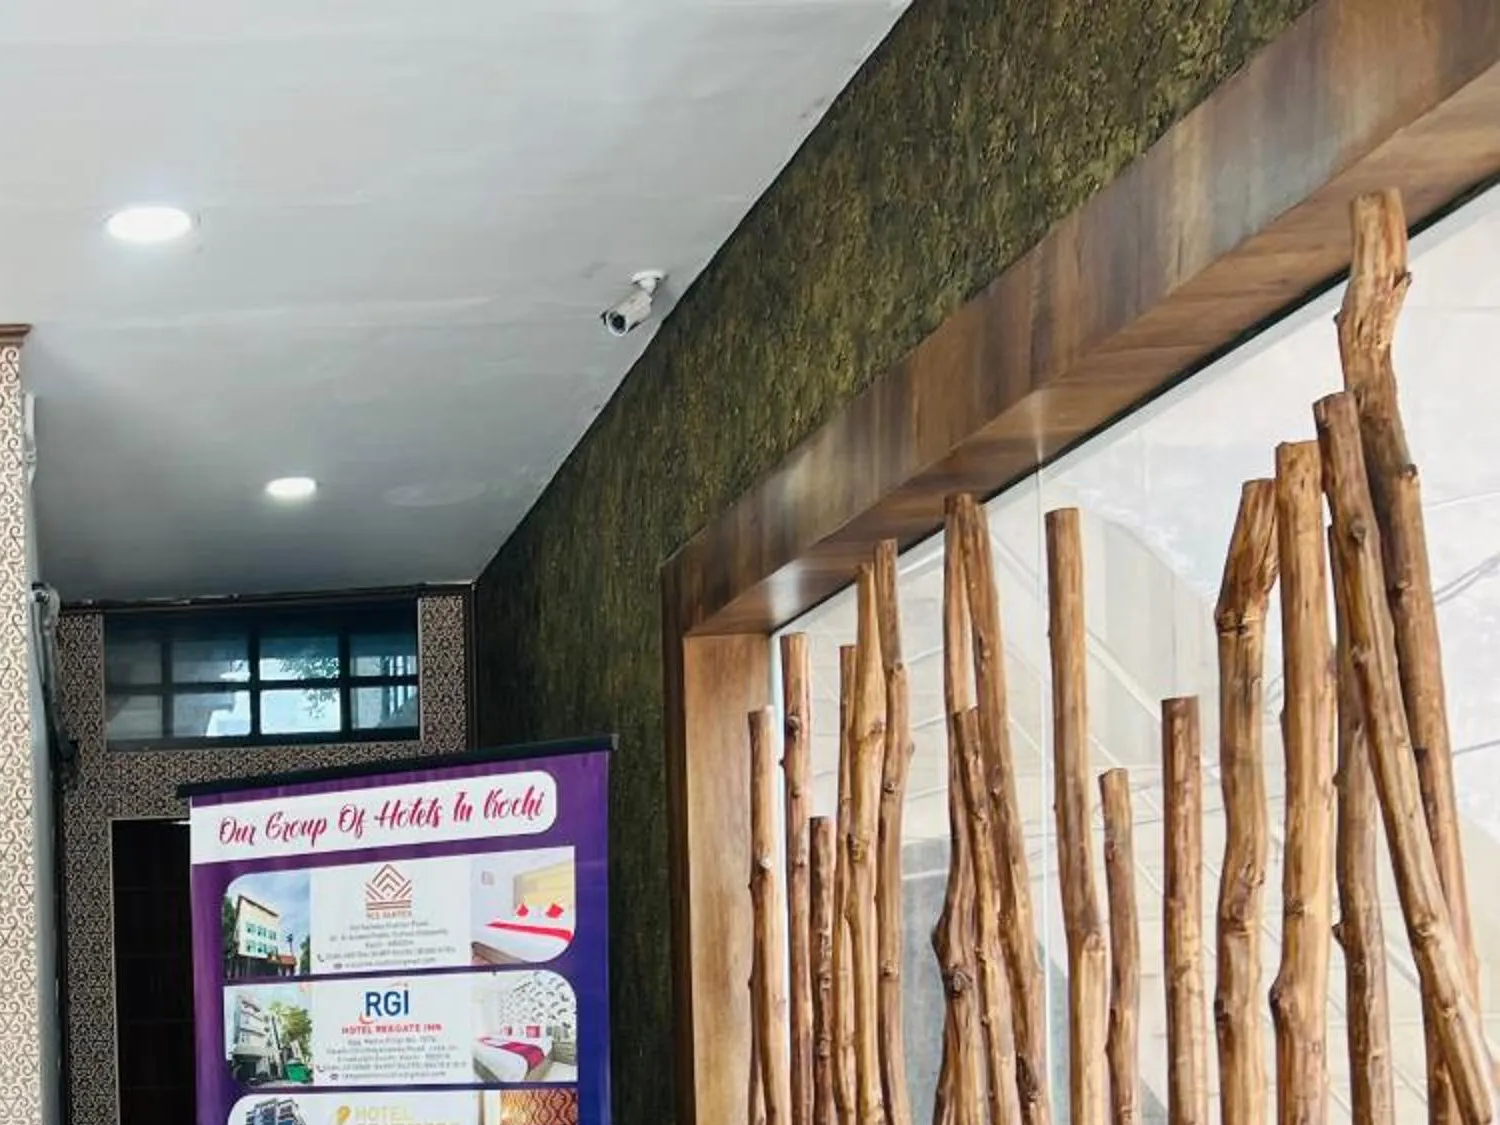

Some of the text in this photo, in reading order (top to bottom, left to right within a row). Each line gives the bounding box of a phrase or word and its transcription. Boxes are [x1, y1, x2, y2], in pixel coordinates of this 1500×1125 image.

[265, 811, 327, 847] Group
[339, 802, 366, 839] Of
[374, 797, 442, 830] Hotels
[483, 786, 545, 819] Kochi
[341, 1025, 373, 1035] HOTEL
[355, 1105, 412, 1121] HOTEL
